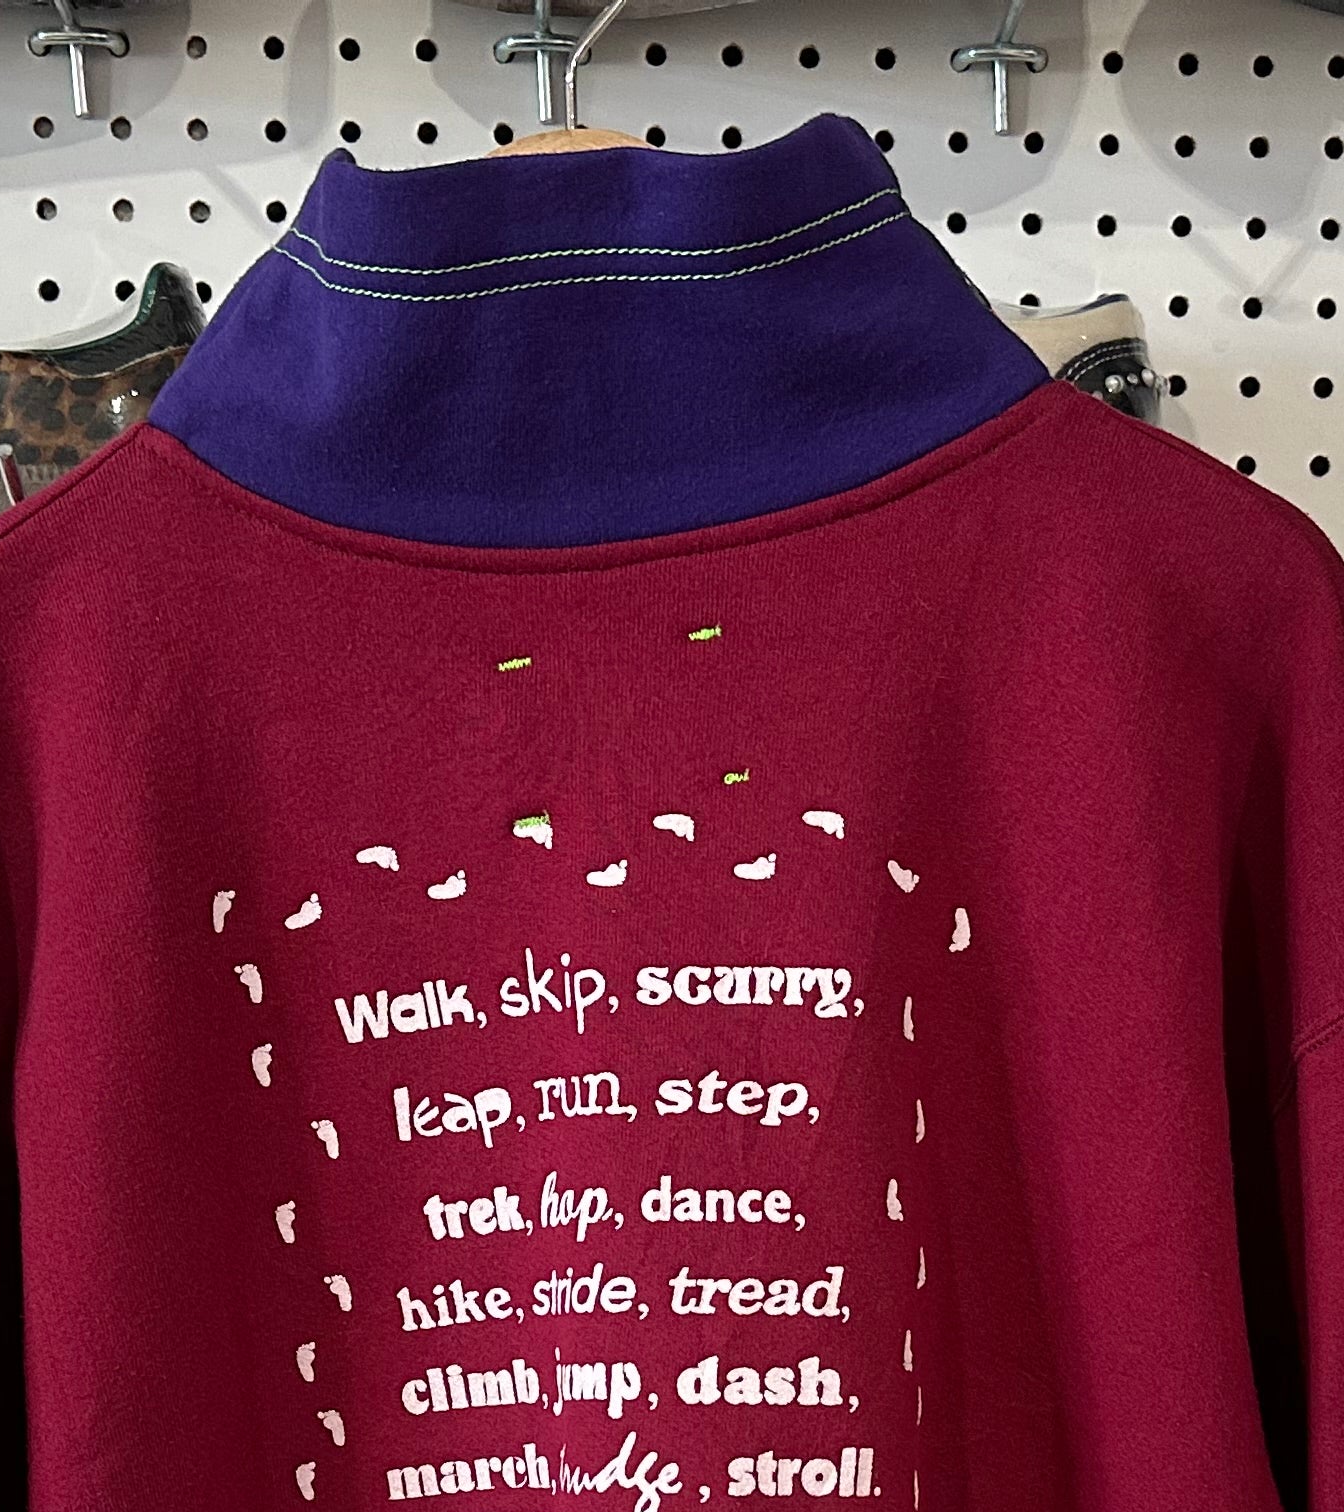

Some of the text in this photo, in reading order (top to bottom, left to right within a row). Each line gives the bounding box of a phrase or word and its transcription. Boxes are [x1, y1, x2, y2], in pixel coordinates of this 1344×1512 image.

[335, 948, 864, 1043] Walk, skip, scurry,
[394, 1070, 819, 1148] leap, run, step,
[423, 1171, 805, 1242] trek, hop, dance,
[397, 1263, 849, 1331] hike, stride, tread,
[402, 1359, 548, 1415] climb,
[677, 1356, 859, 1413] dash,
[387, 1443, 556, 1500] march,
[728, 1447, 881, 1497] stroll.
